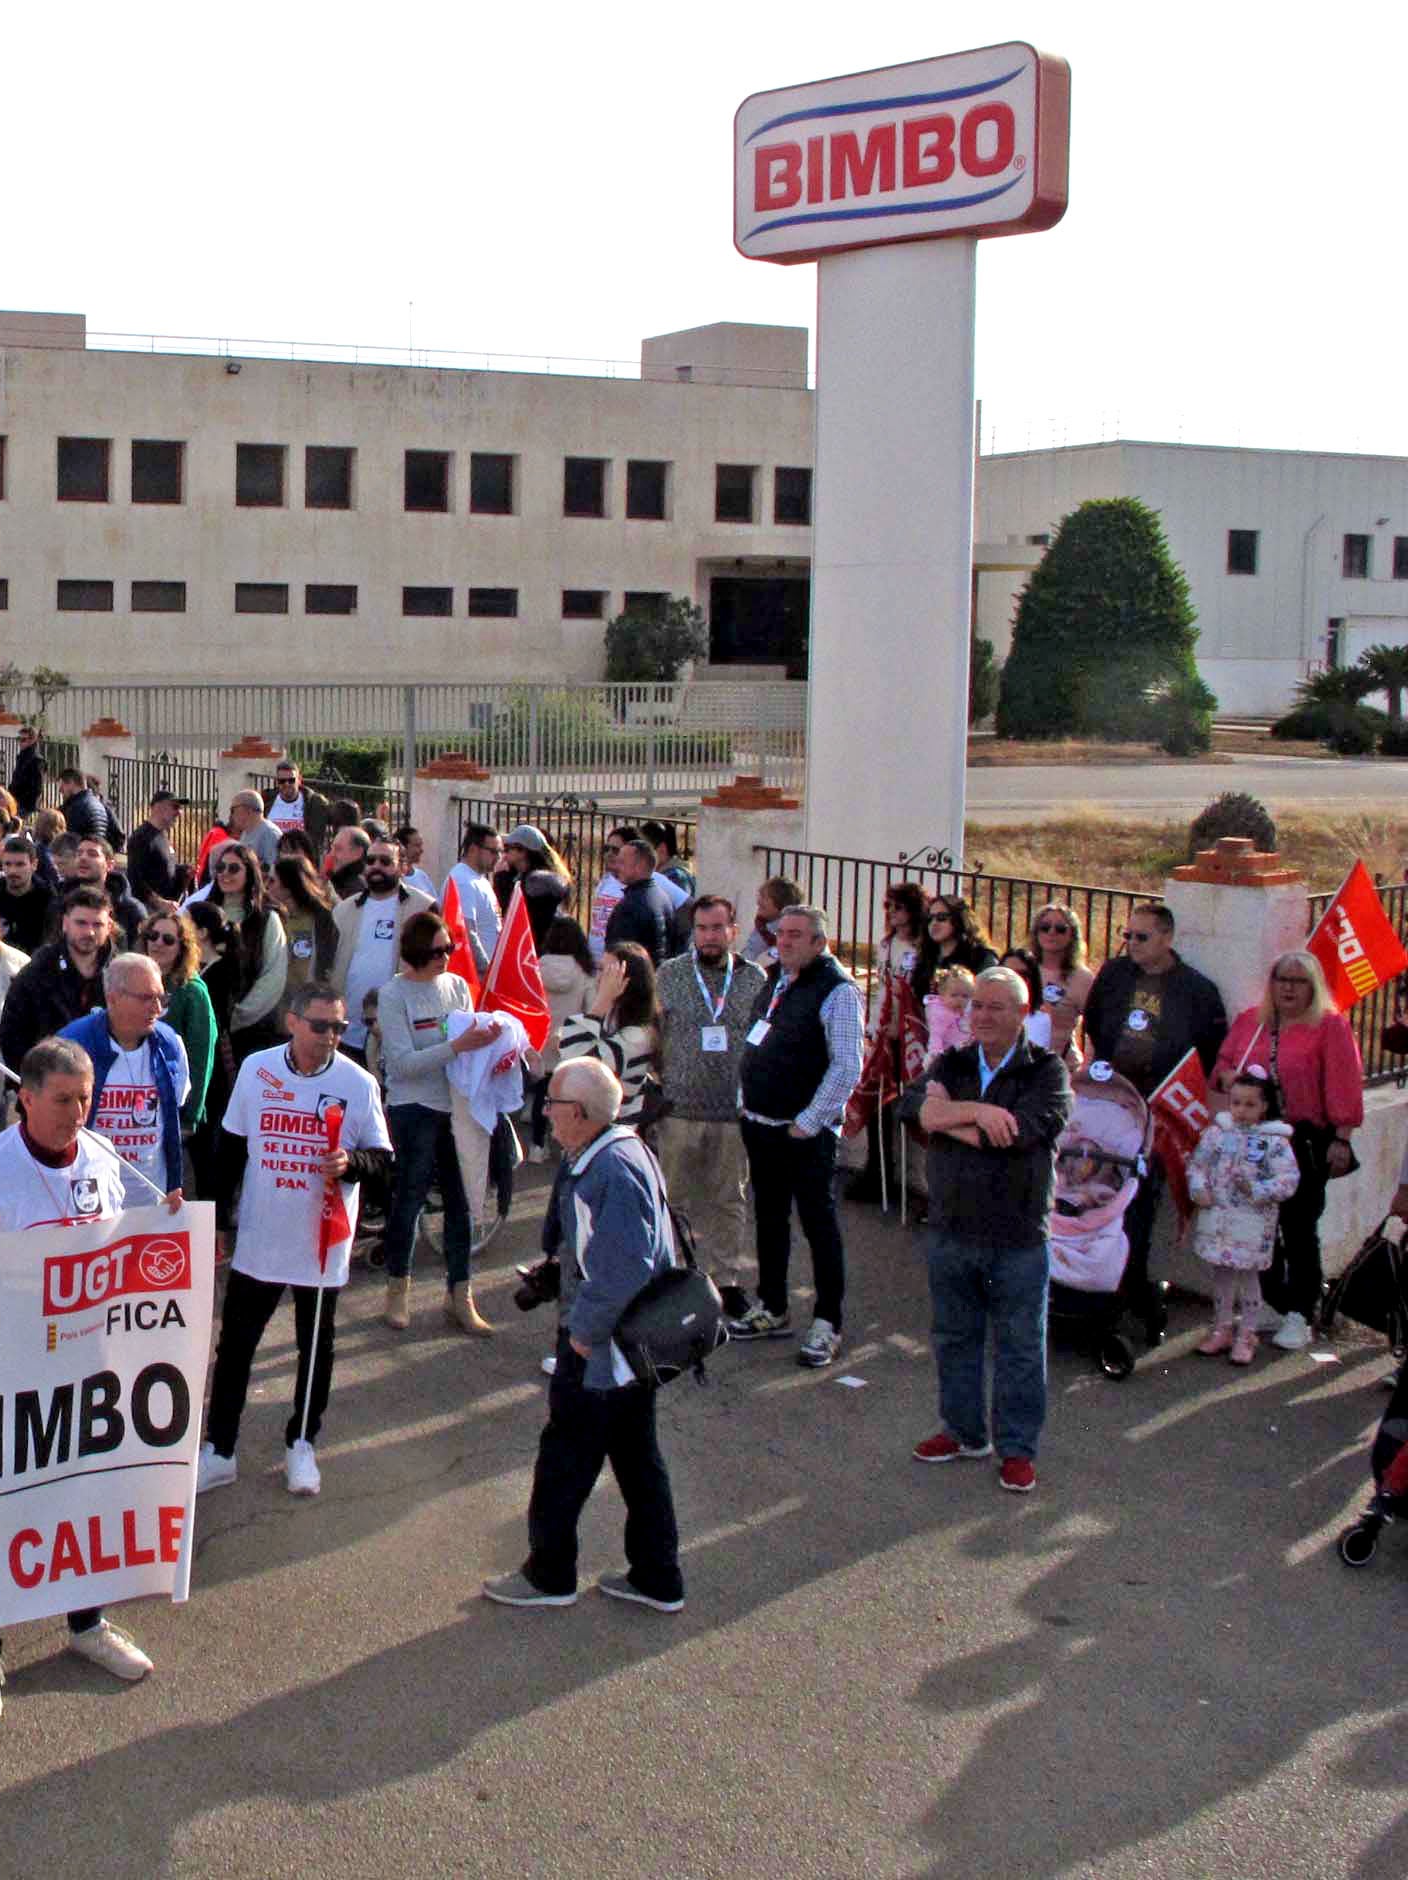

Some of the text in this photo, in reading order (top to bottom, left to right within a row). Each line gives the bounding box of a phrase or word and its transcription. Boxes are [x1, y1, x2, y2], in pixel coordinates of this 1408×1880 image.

[754, 101, 1015, 212] BIMBO
[263, 1142, 277, 1153] SE
[50, 1244, 133, 1308] UGT
[106, 1299, 187, 1336] FICA
[8, 1506, 186, 1589] CALLE
